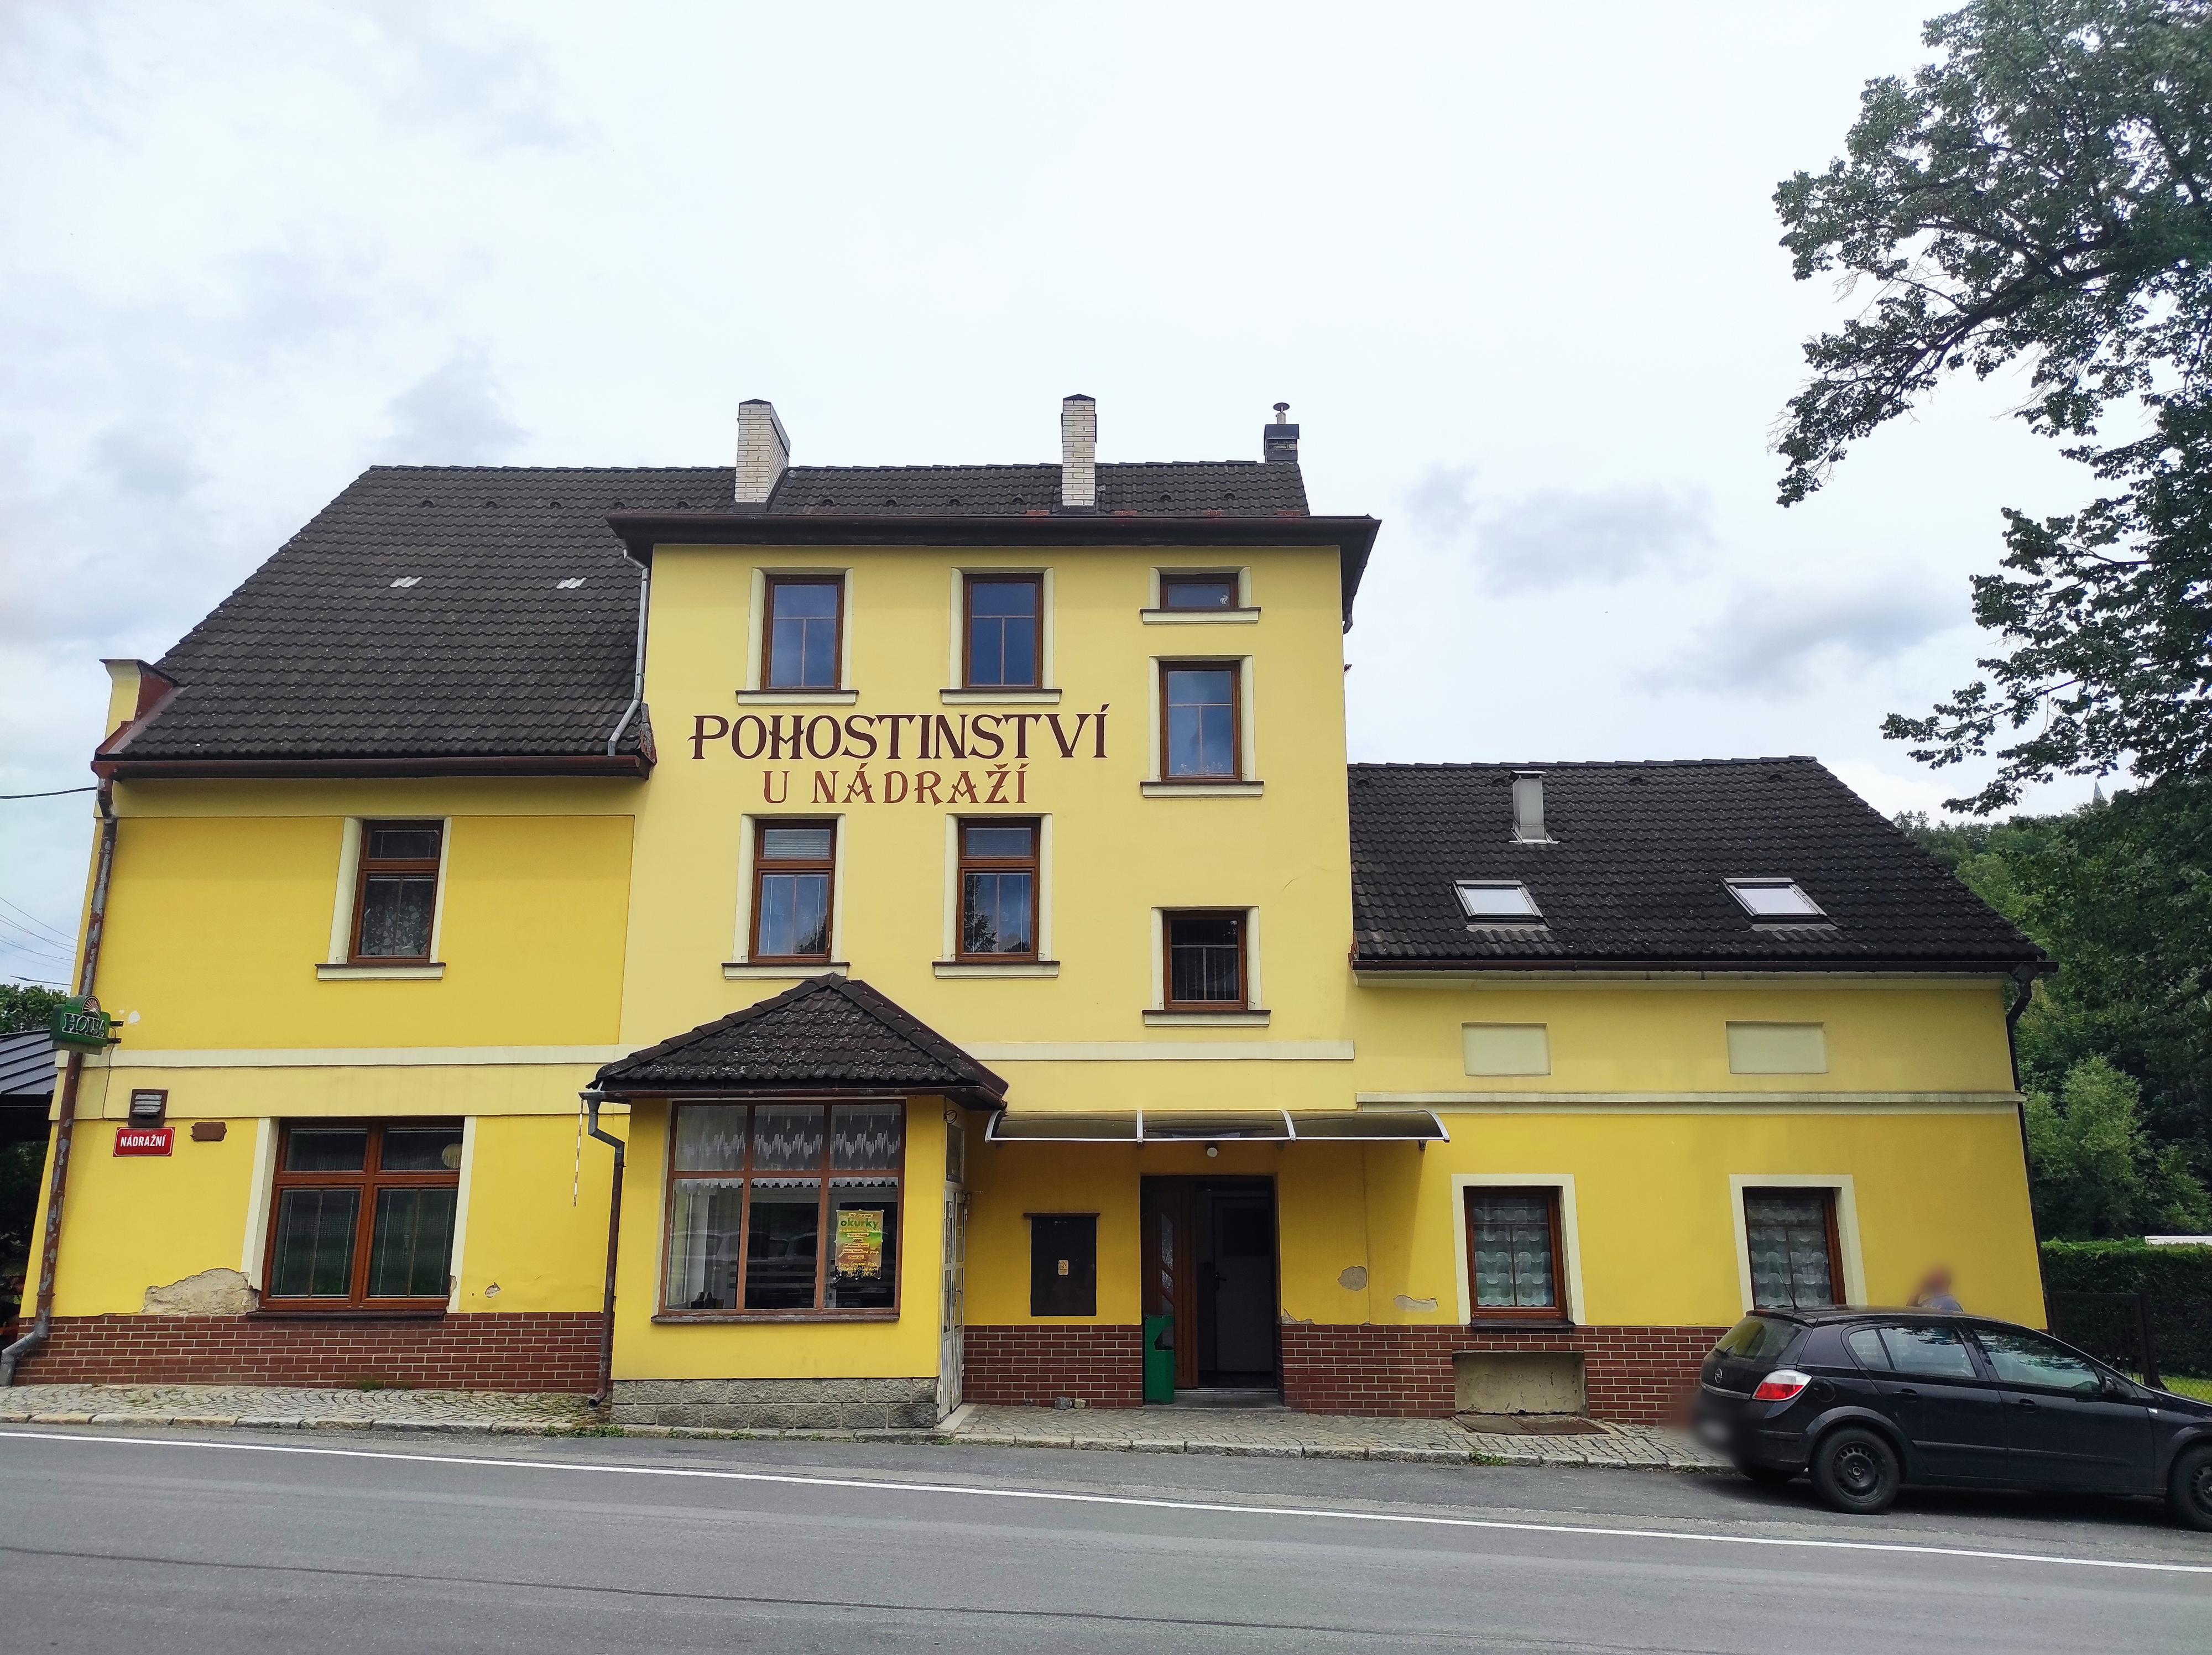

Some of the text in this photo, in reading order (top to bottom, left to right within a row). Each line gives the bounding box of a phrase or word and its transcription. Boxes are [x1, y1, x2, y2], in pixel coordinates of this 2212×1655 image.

[686, 703, 1110, 760] POHOSTINSTVÍ
[762, 762, 1030, 807] U NÁDRAŽÍ
[62, 1012, 107, 1040] HOLBA
[120, 1134, 167, 1147] NÁDRAŽNÍ
[840, 1217, 879, 1230] okurky
